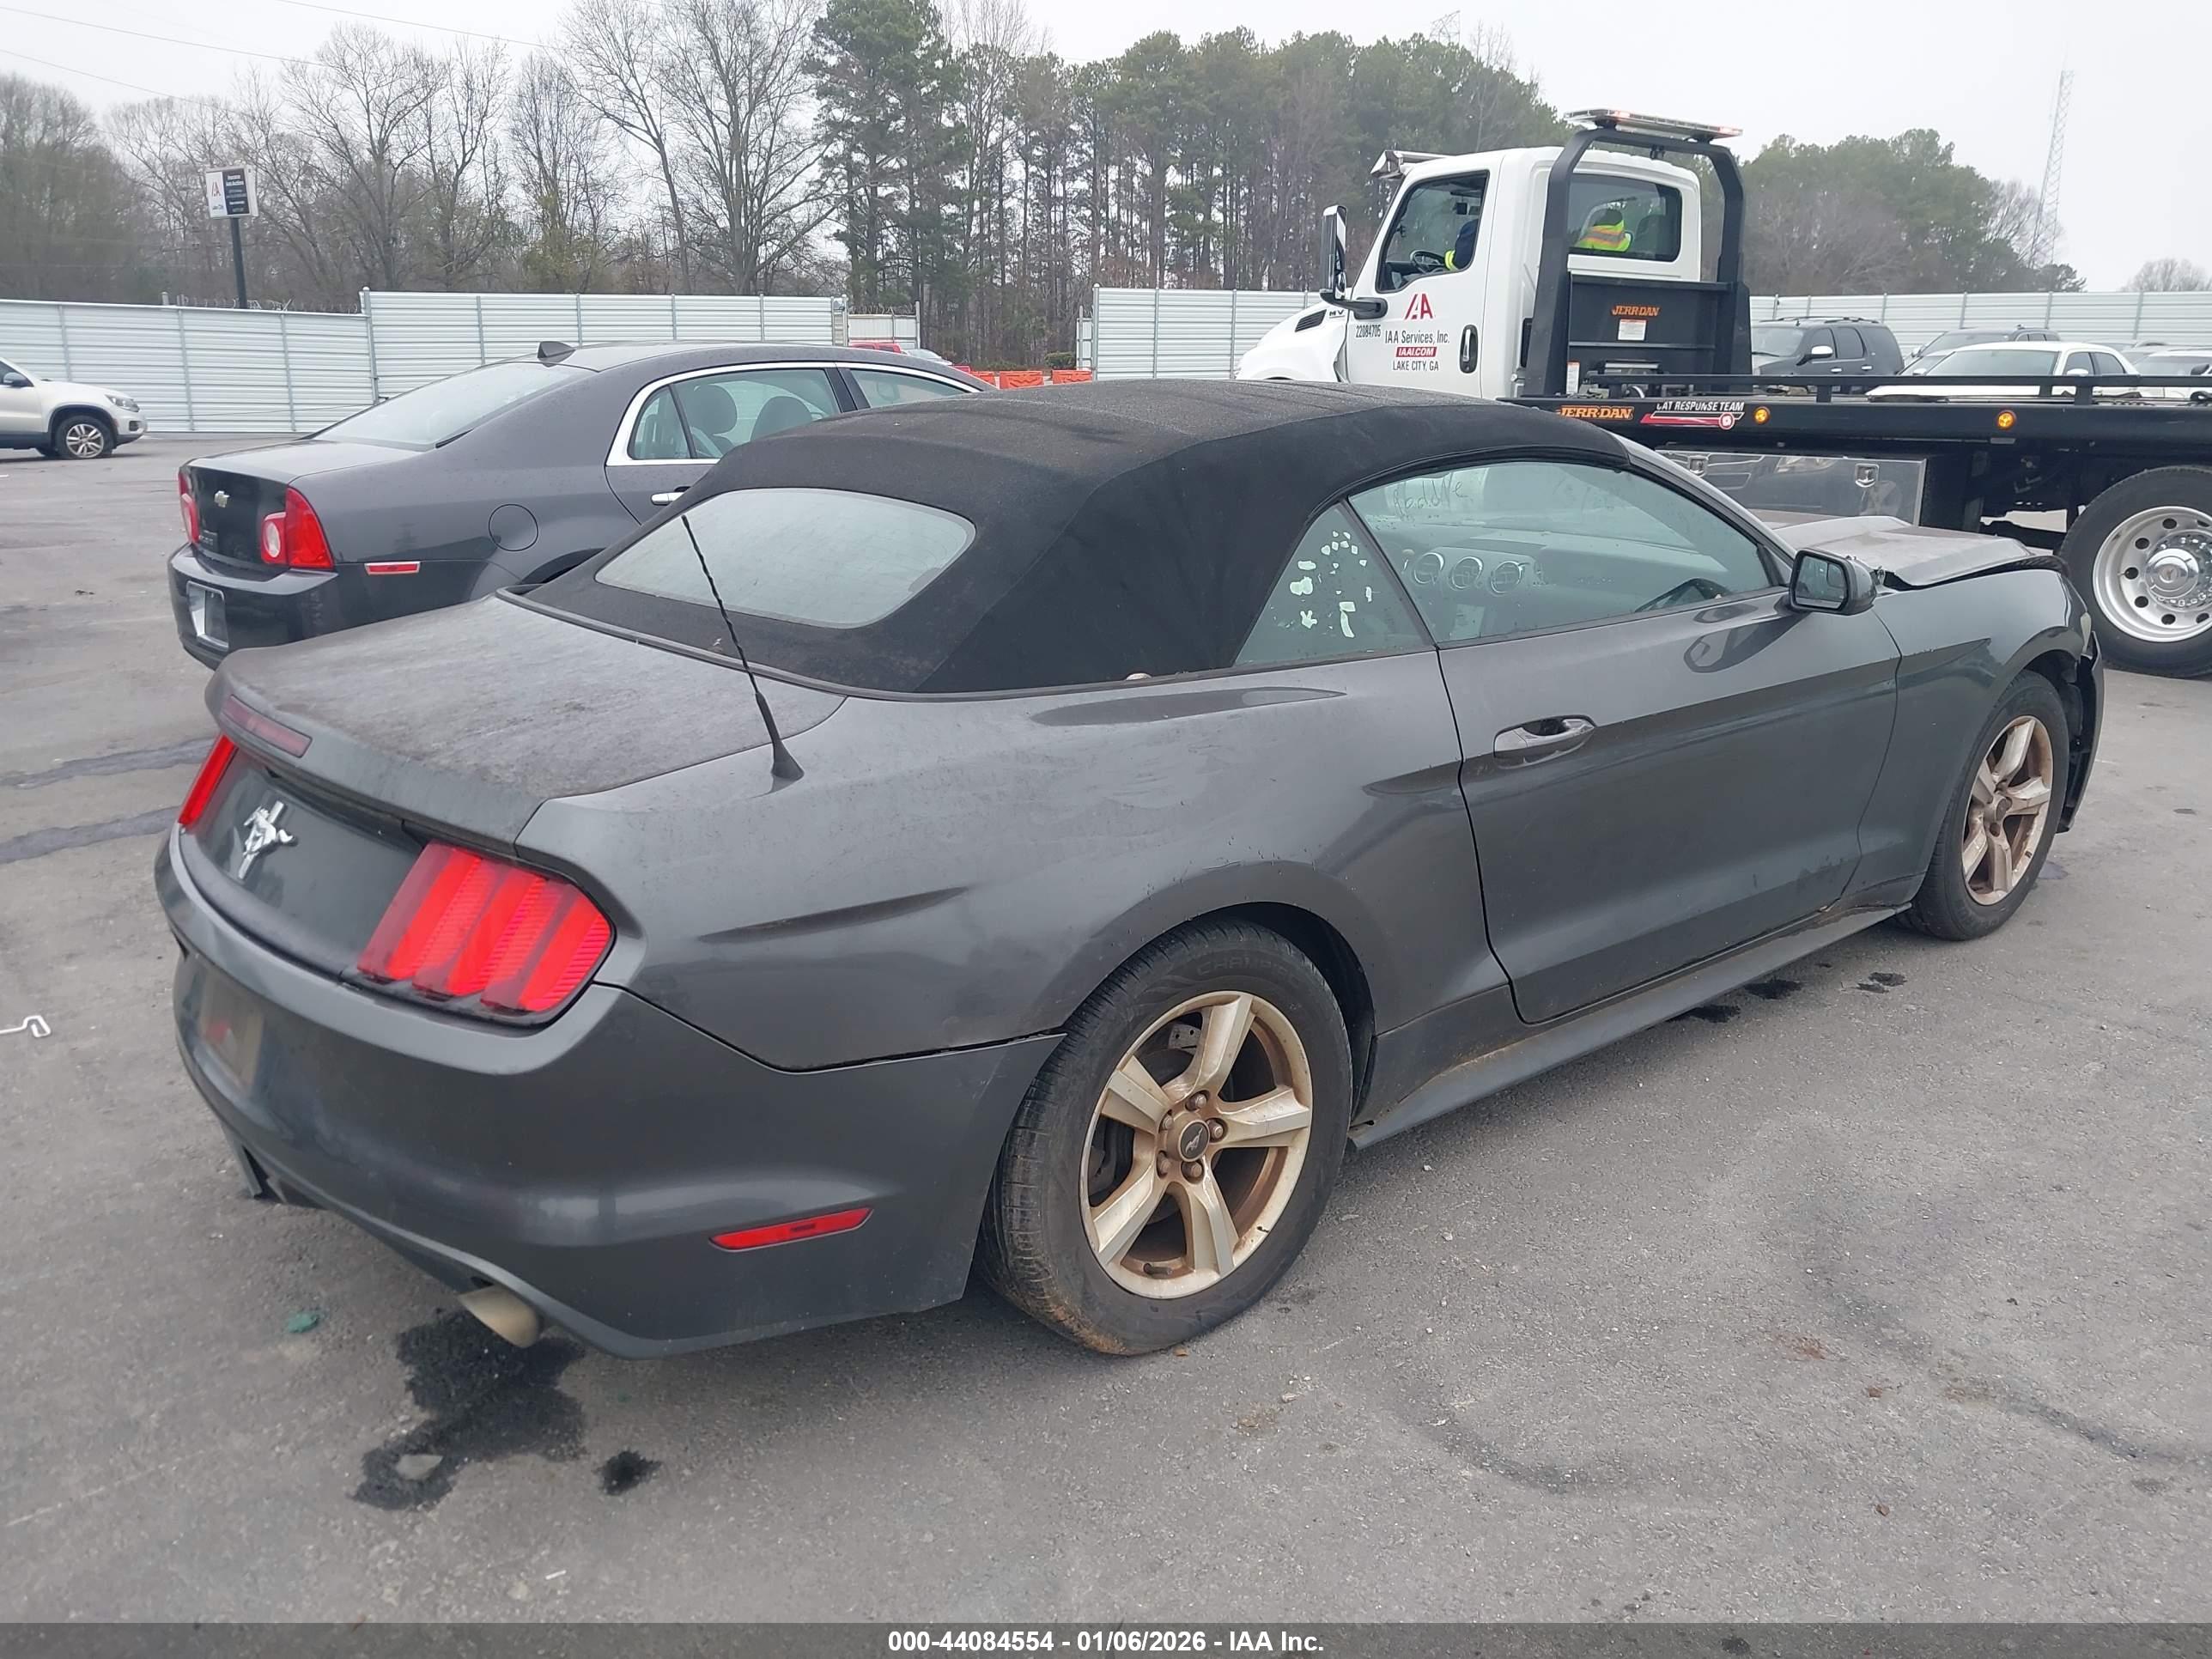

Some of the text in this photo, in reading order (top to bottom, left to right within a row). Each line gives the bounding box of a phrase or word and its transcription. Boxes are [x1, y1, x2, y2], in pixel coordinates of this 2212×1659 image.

[1356, 324, 1381, 337] 22084705
[1385, 330, 1450, 344] IAA Services, Inc.
[1398, 347, 1434, 356] IAAI.COM
[1393, 361, 1409, 371] LAKE
[1430, 361, 1439, 371] GA
[1720, 401, 1745, 411] TEAM
